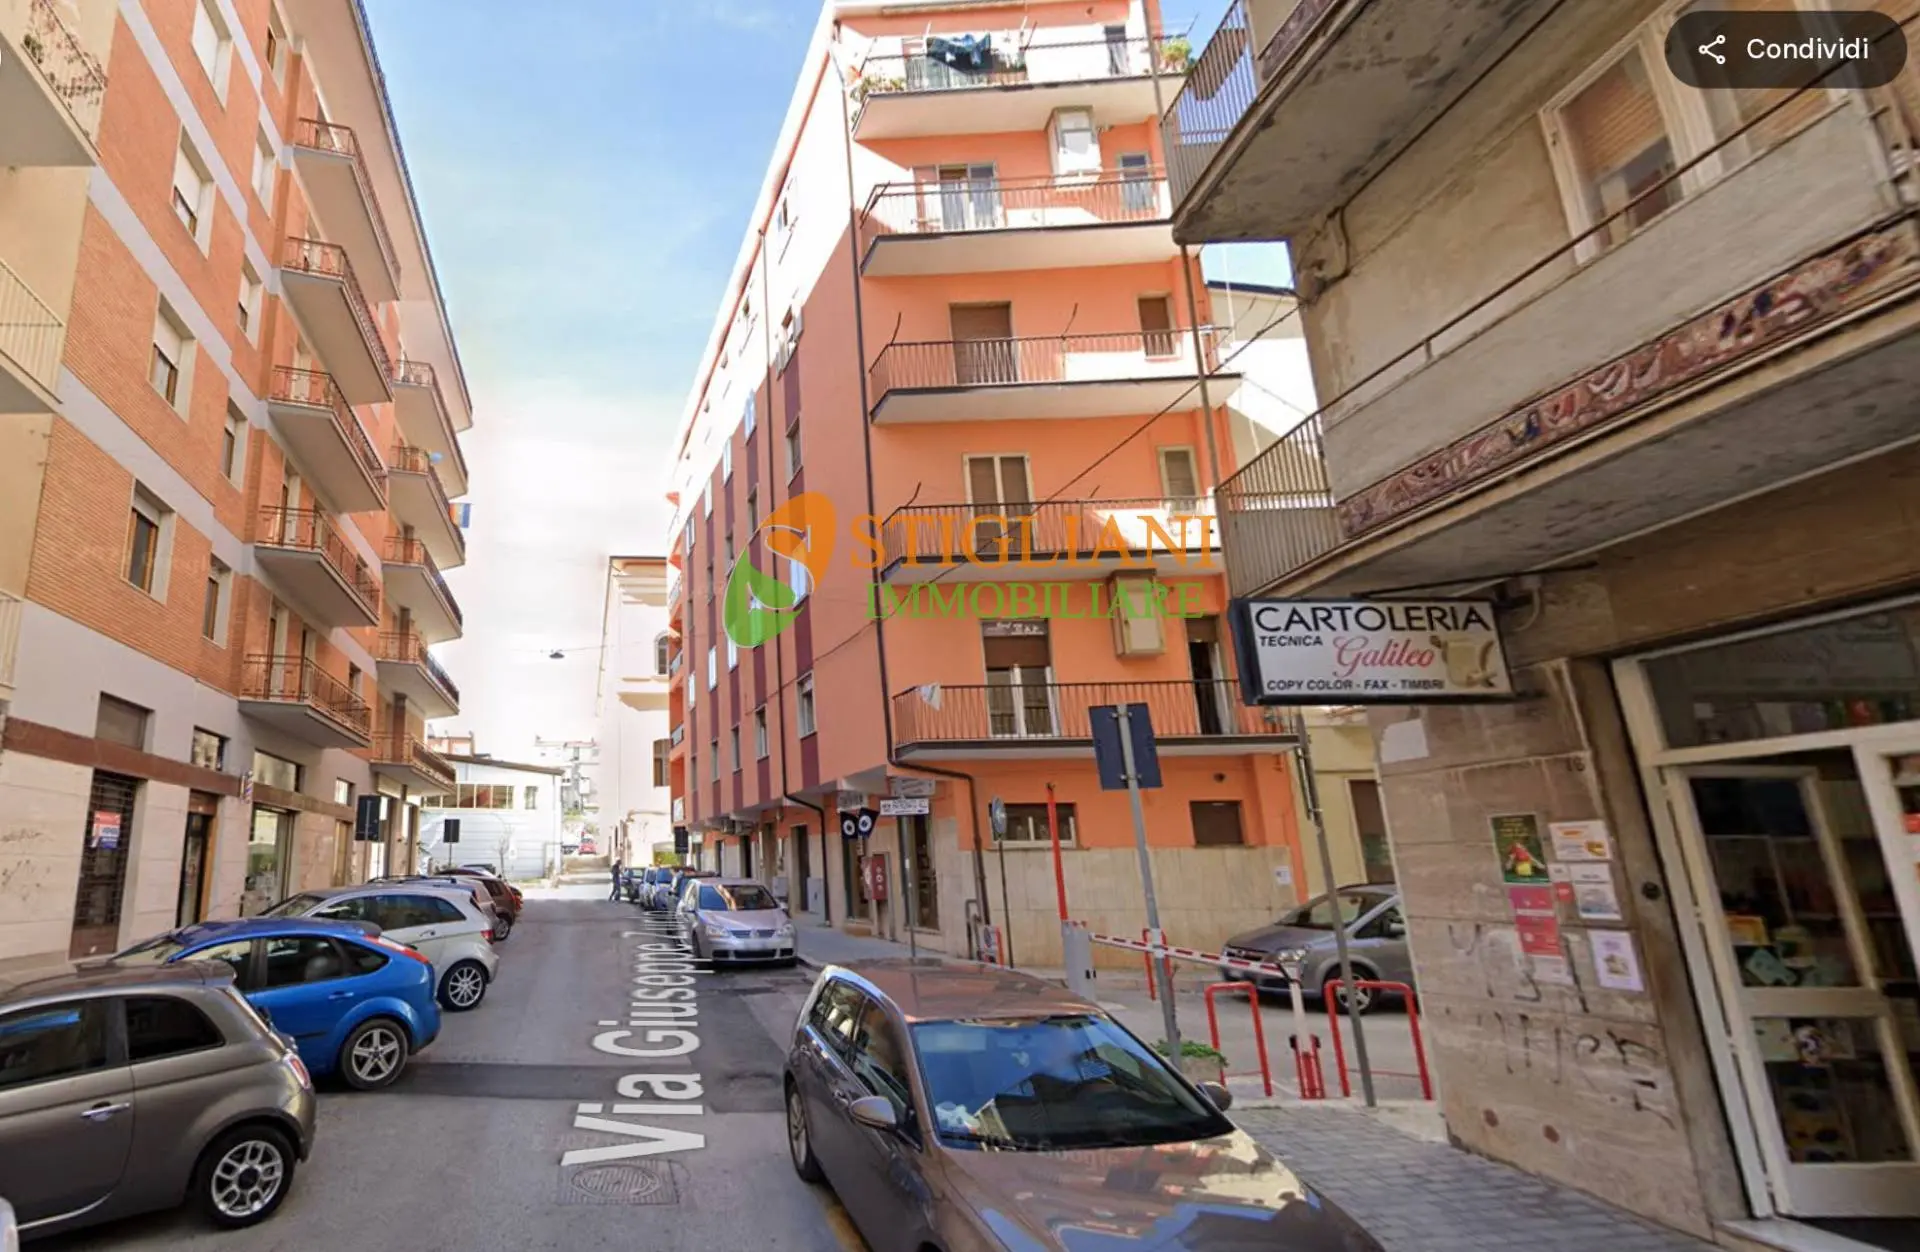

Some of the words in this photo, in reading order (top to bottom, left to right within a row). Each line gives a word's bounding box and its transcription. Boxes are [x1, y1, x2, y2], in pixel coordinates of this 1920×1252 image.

[1255, 605, 1493, 632] CARTOLERIA
[1260, 635, 1324, 648] TECNICA
[1331, 635, 1437, 678] Galileo
[1266, 679, 1304, 691] COPY
[1306, 679, 1353, 691] COLOR
[1364, 679, 1389, 691] FAX
[1399, 679, 1446, 691] TIMBRI
